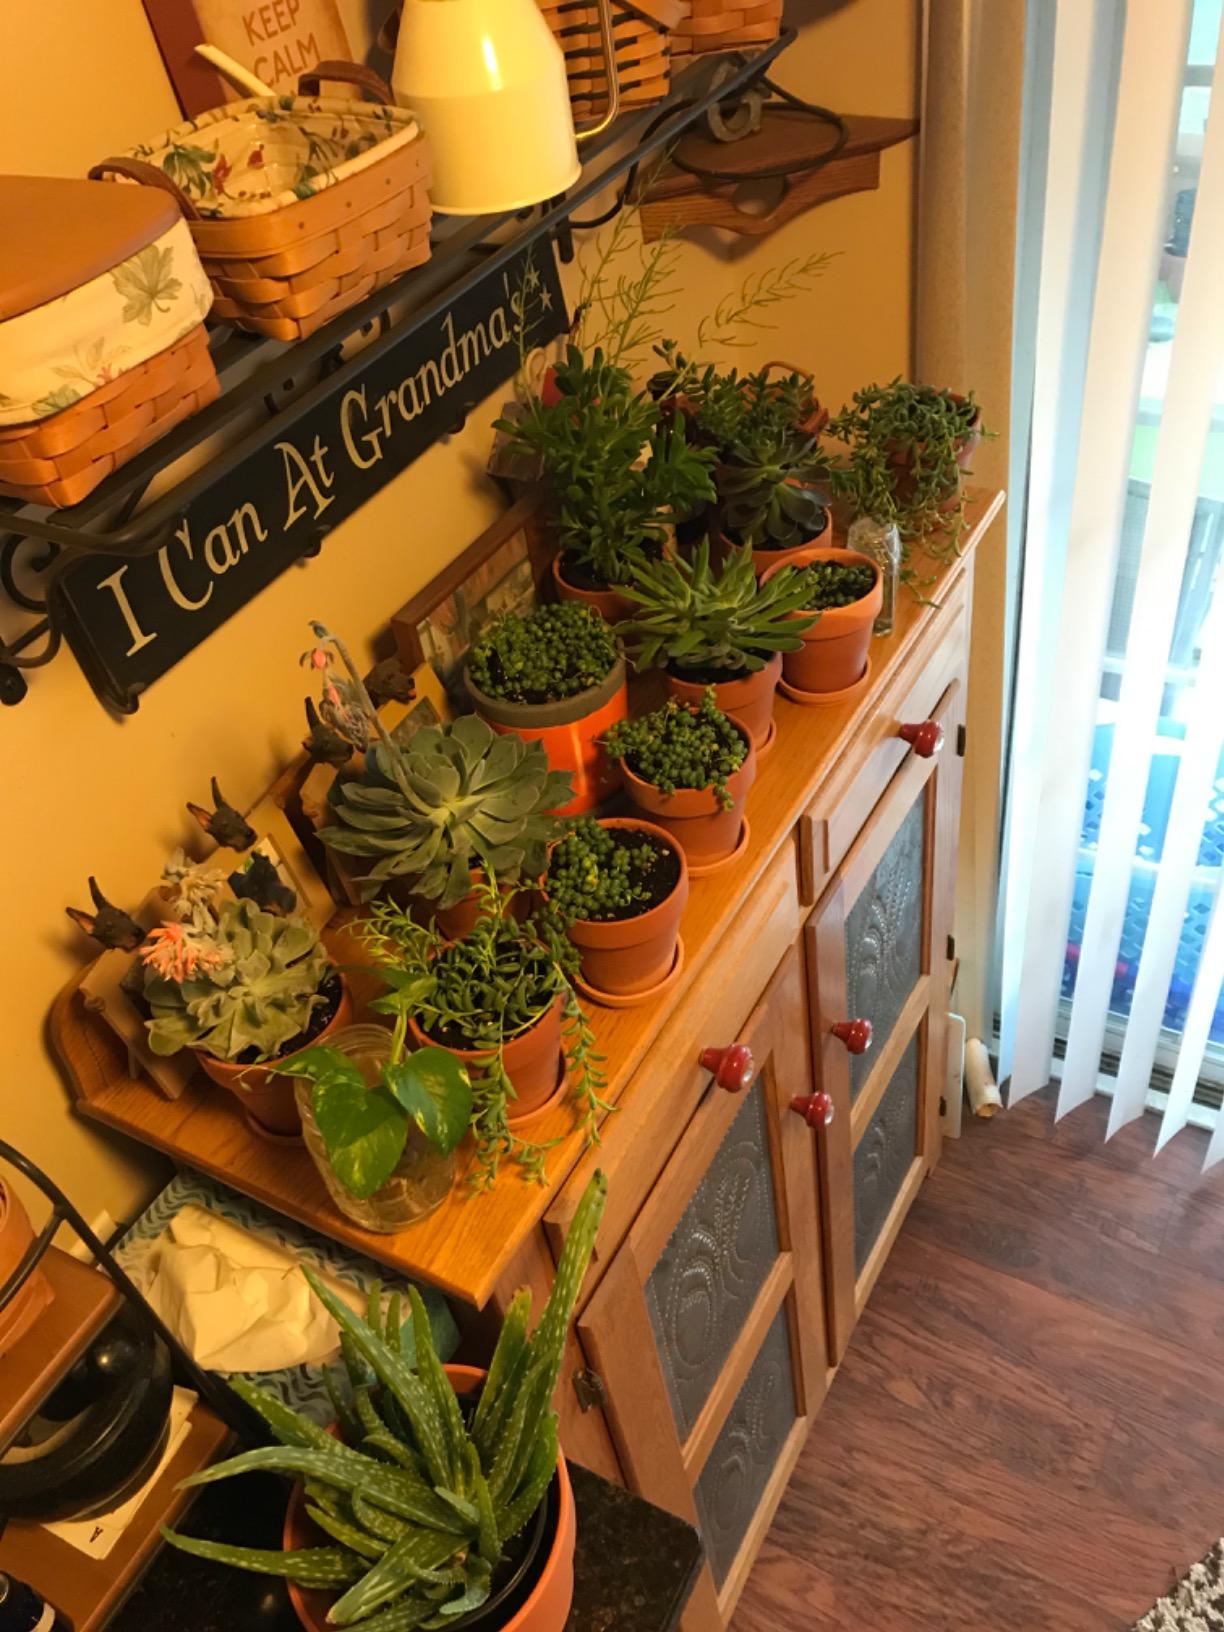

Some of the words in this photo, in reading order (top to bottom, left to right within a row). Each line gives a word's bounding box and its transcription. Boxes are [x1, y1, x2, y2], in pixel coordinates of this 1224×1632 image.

[242, 0, 300, 47] KEEP
[254, 31, 321, 88] CALM
[97, 564, 158, 657] I
[158, 502, 268, 610] Can
[274, 435, 335, 531] At
[340, 271, 526, 469] Grandma's
